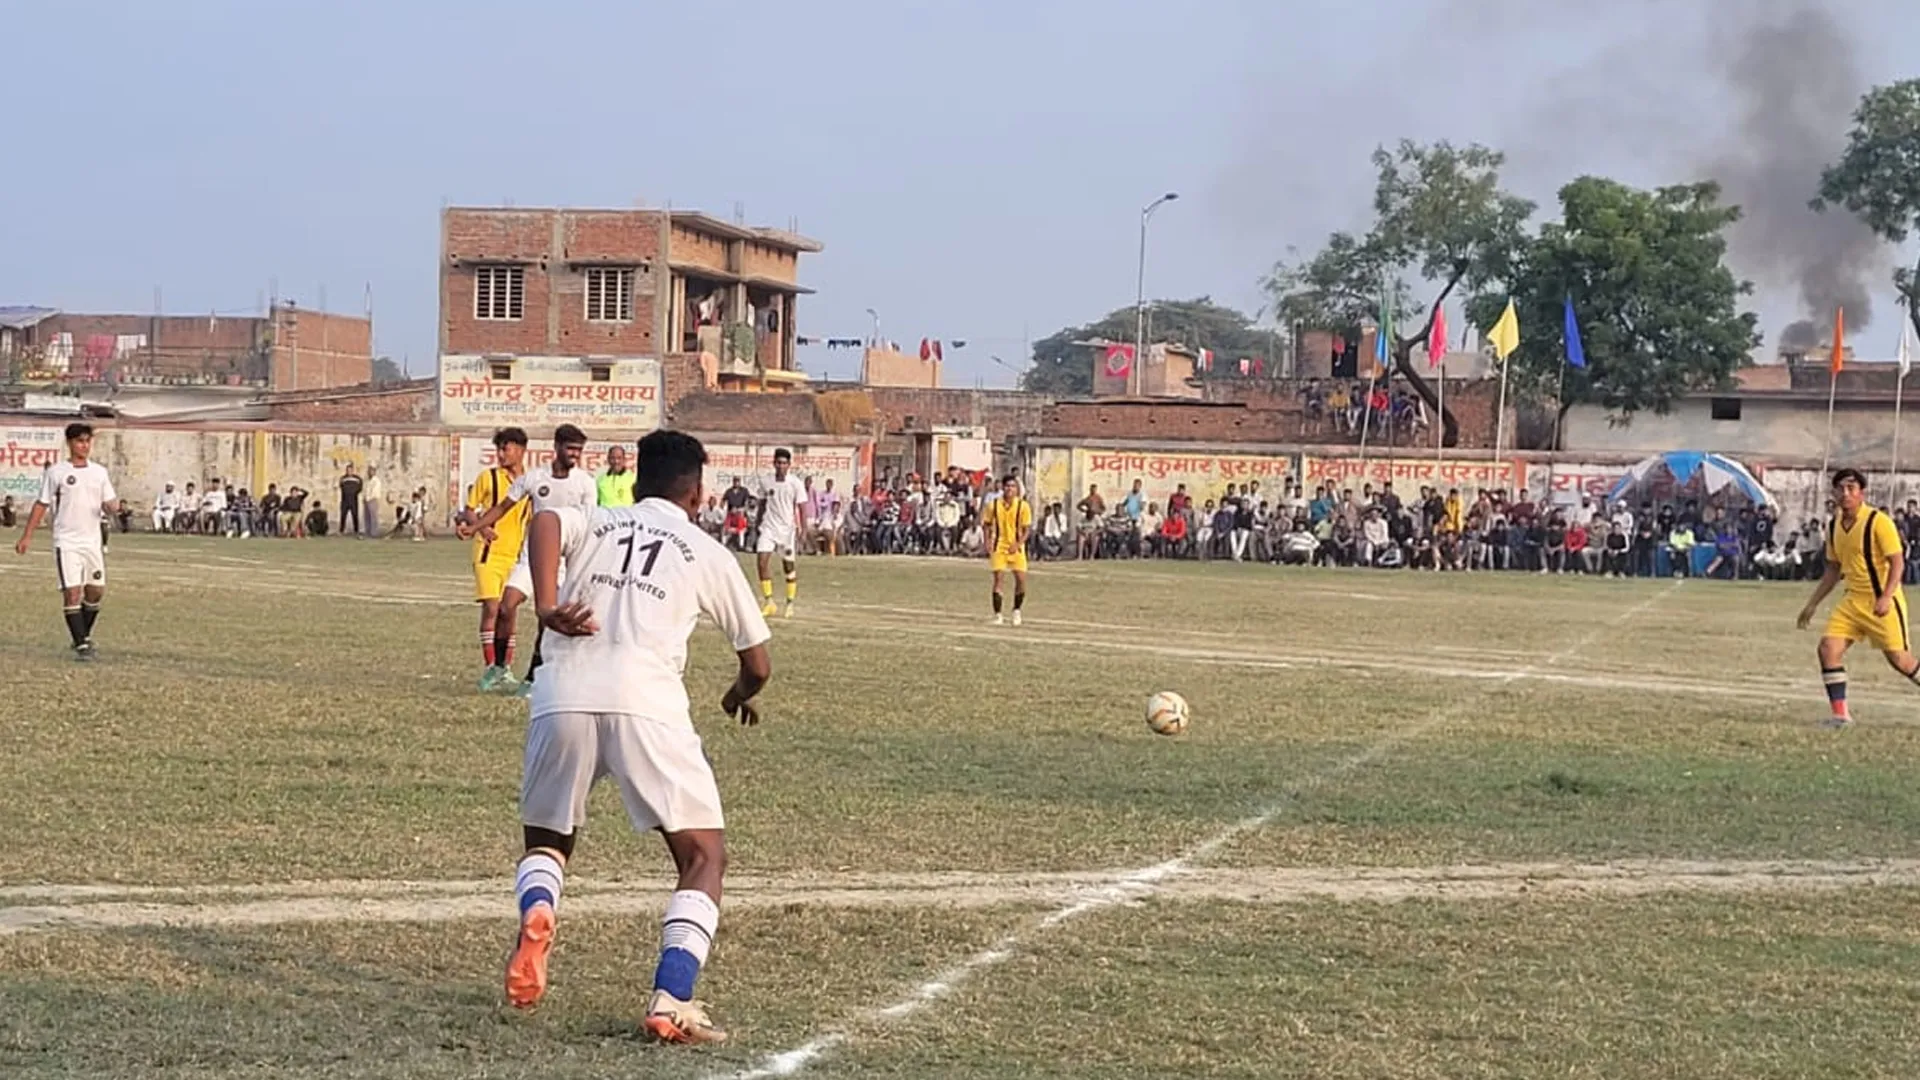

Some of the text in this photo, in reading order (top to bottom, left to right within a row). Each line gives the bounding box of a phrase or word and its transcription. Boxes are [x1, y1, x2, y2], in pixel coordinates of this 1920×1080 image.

[530, 383, 593, 404] कुमार
[596, 384, 656, 402] शाक्य
[1148, 456, 1212, 479] कुमार
[617, 533, 664, 577] 11
[647, 526, 695, 563] VENTURES
